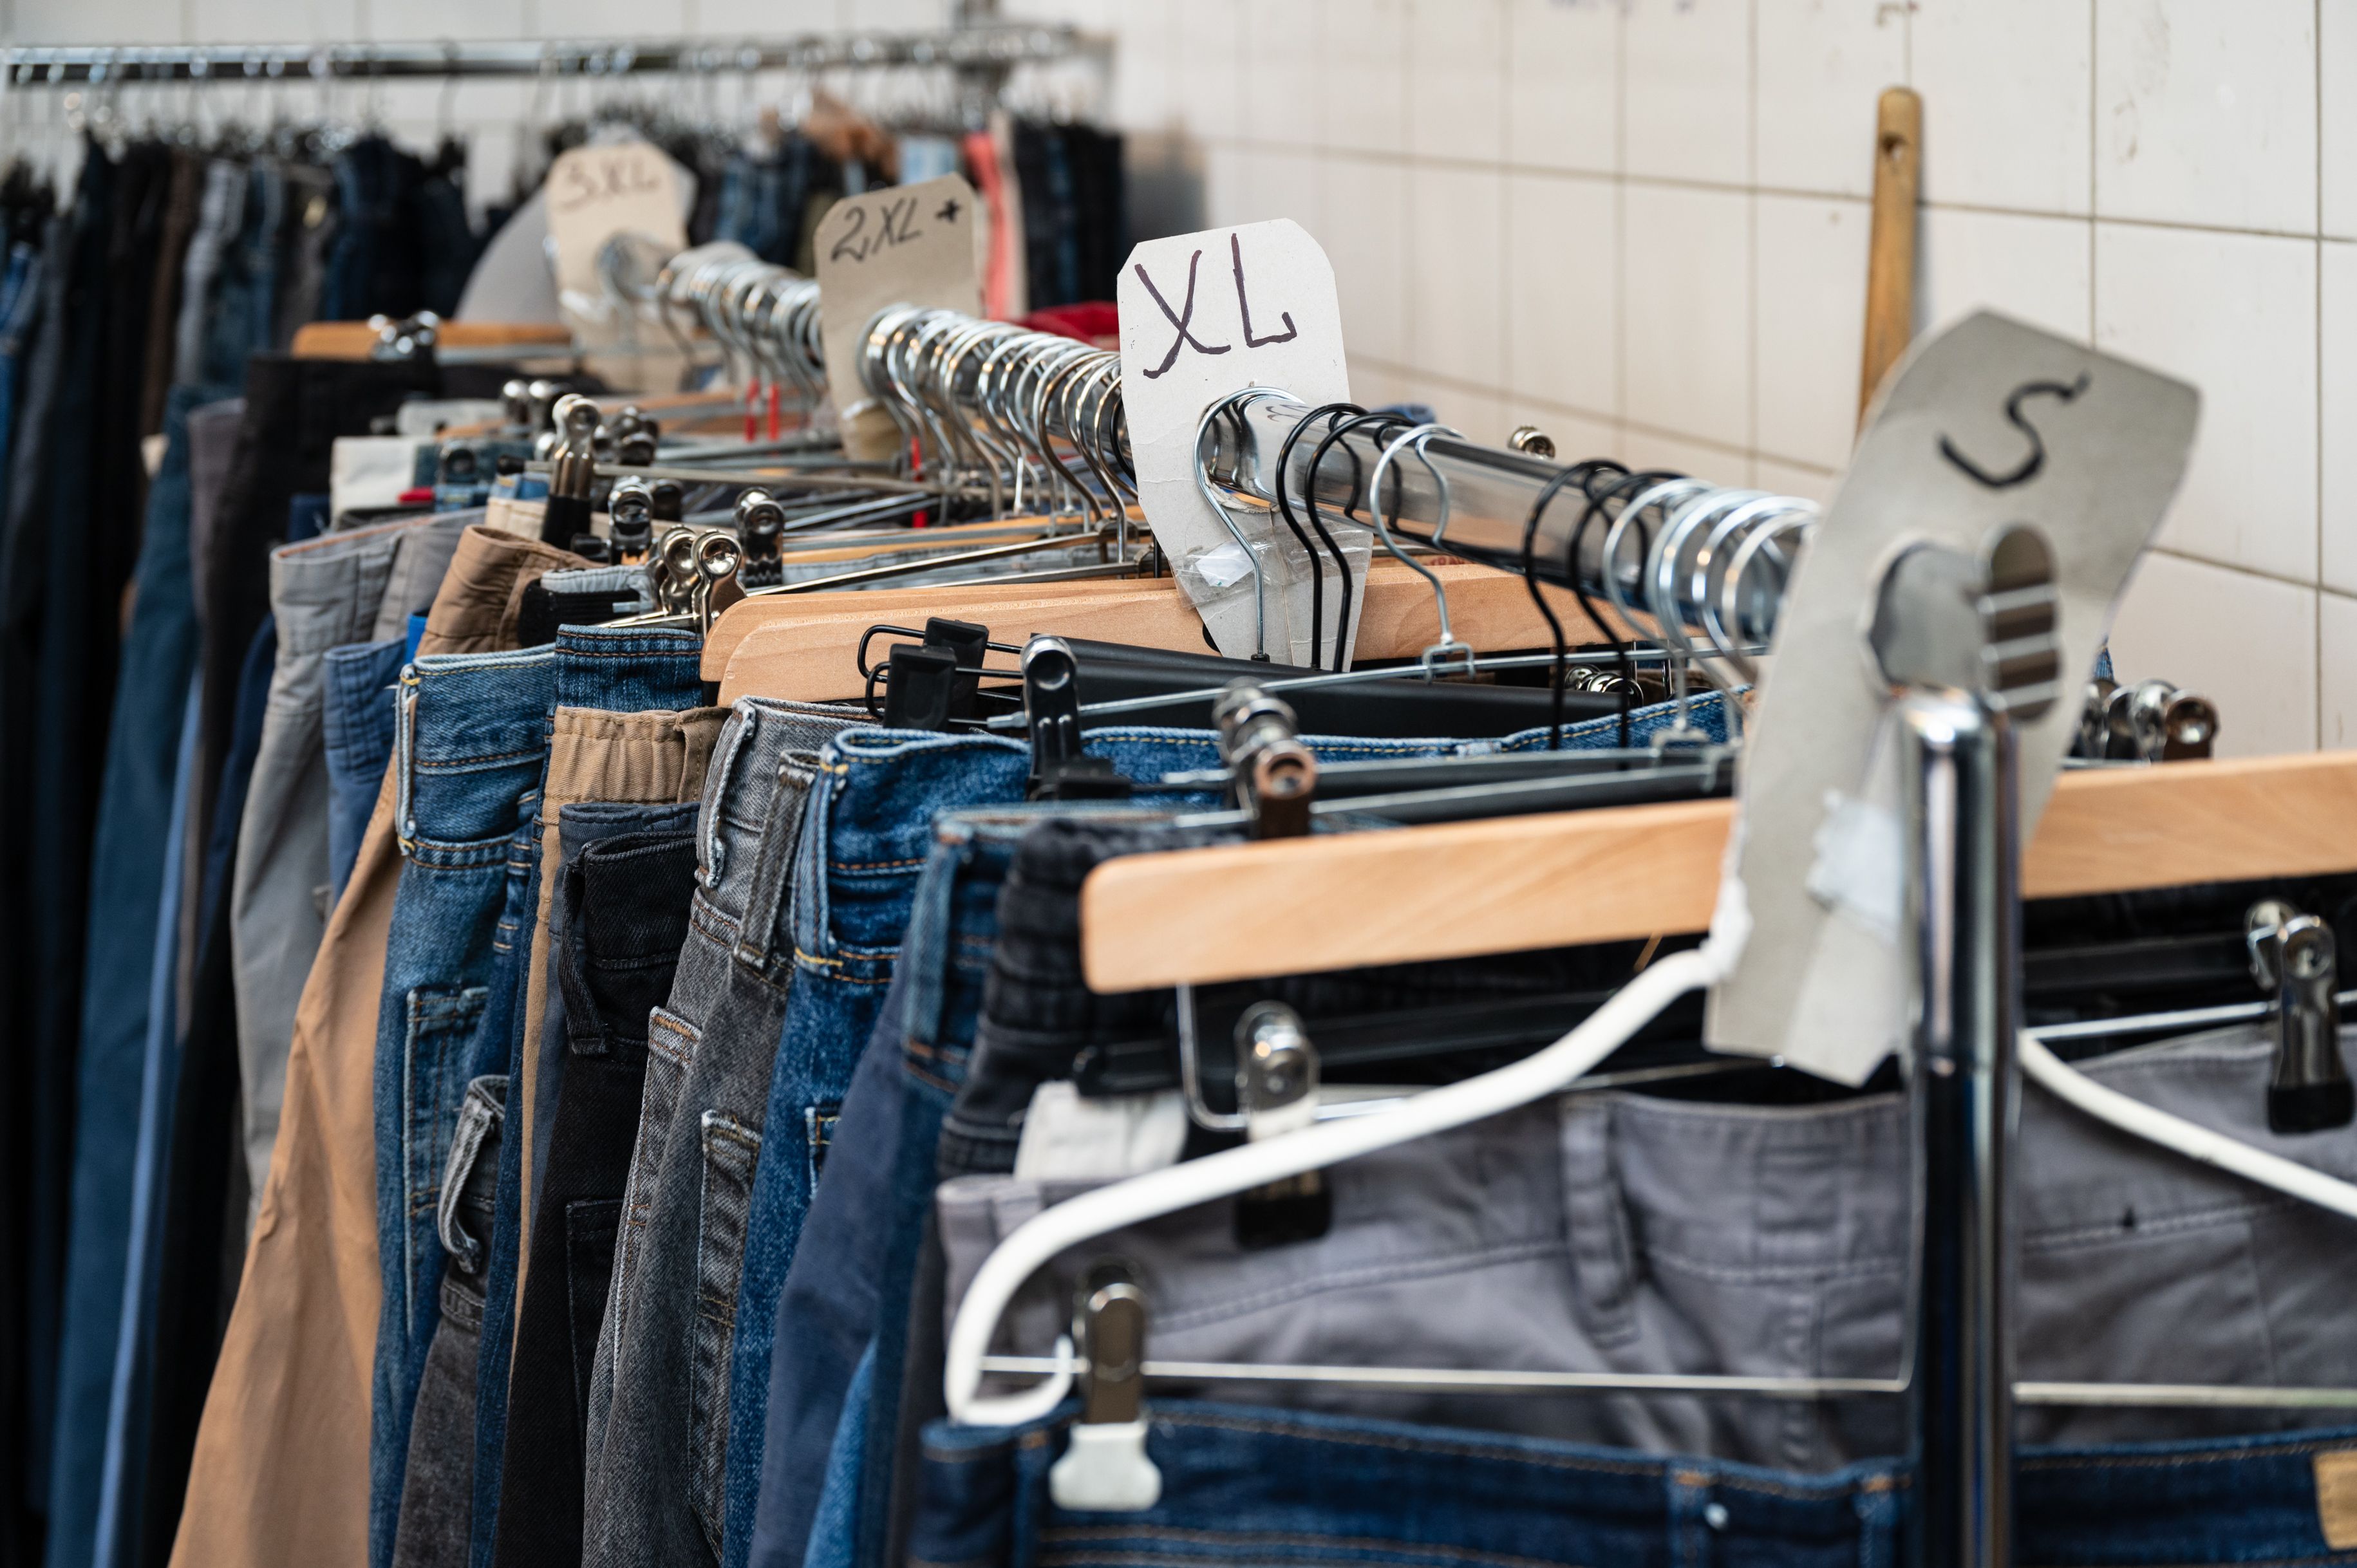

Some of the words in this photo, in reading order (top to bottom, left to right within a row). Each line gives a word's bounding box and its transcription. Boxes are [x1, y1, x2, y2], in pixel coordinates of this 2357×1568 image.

[831, 197, 922, 261] 2XL
[1134, 232, 1297, 379] XL
[1936, 369, 2092, 491] S
